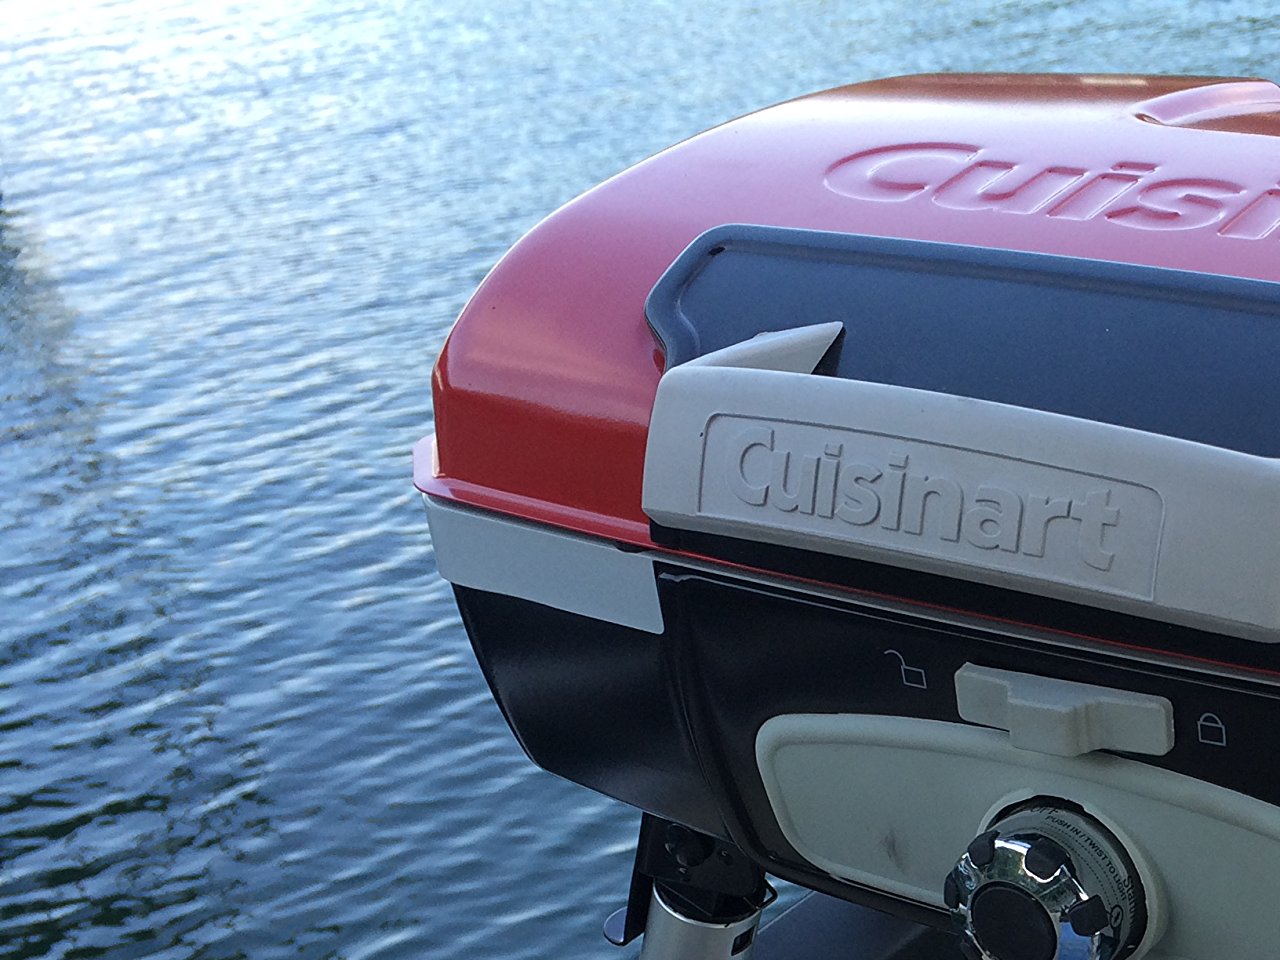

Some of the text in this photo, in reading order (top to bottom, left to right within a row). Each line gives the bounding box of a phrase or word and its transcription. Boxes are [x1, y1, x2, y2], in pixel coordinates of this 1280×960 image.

[727, 426, 1122, 573] Cuisinart
[1045, 815, 1072, 830] PUSH
[1084, 836, 1108, 861] TWIST
[1106, 860, 1116, 874] TO
[1113, 873, 1127, 900] LIGHT
